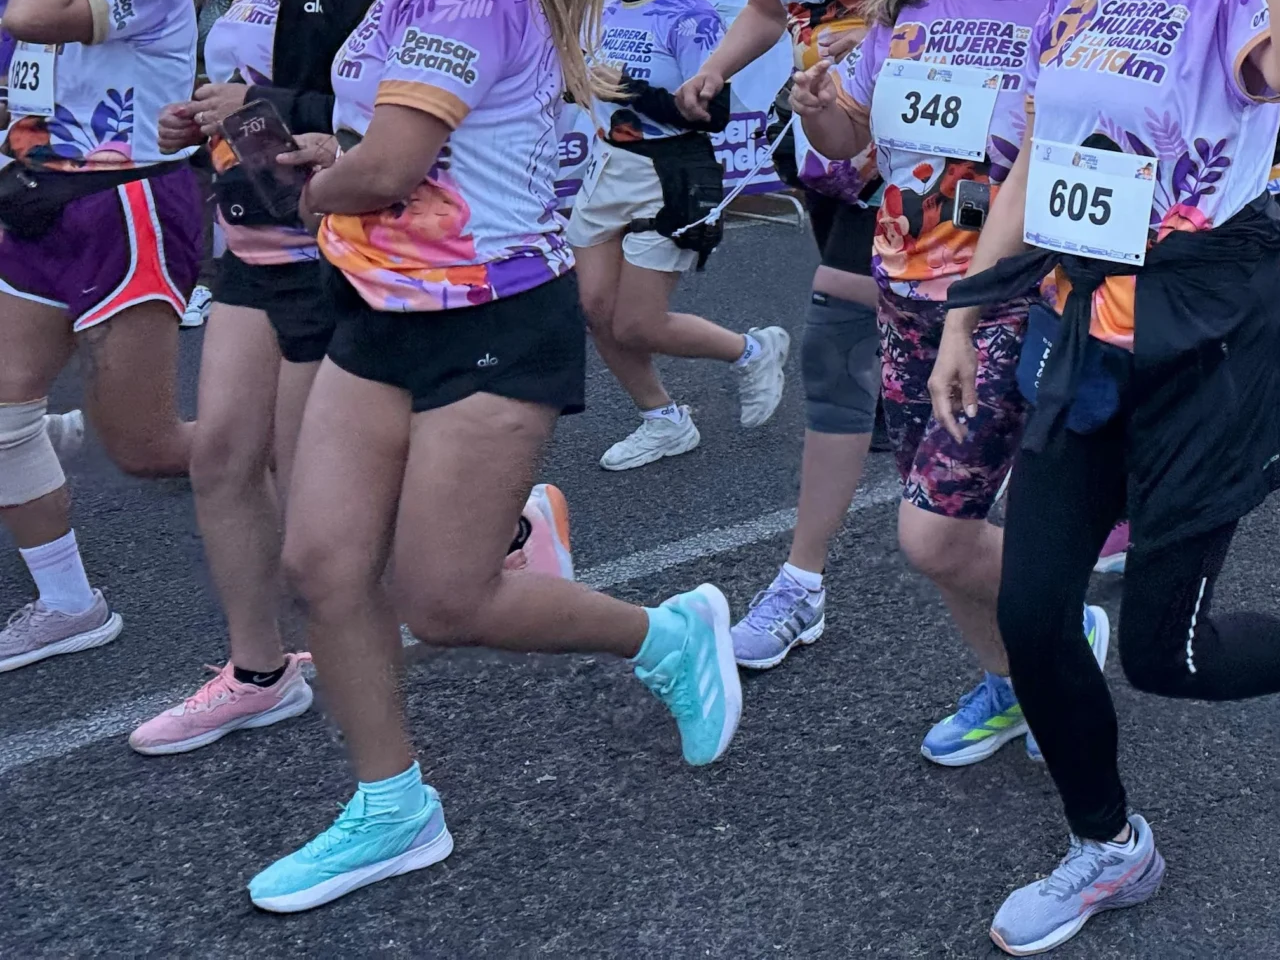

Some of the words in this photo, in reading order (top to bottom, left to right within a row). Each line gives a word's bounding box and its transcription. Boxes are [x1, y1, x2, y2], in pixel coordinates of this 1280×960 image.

[1102, 0, 1176, 20] CARRERA
[607, 28, 648, 41] CARRERA
[930, 20, 1014, 38] CARRERA
[1089, 16, 1182, 42] MUJERES
[402, 29, 477, 62] Pensar
[602, 38, 654, 54] MUJERES
[926, 35, 1028, 58] MUJERES
[1082, 33, 1089, 43] Y
[1090, 35, 1106, 47] LA
[1103, 36, 1172, 56] IGUALDAD
[400, 46, 476, 85] Grande
[608, 52, 652, 63] IGUALDAD
[950, 54, 1024, 68] IGUALDAD
[1065, 46, 1082, 66] 5
[1083, 48, 1100, 70] Y
[1099, 50, 1166, 84] 10km
[901, 91, 962, 128] 348
[240, 117, 266, 138] 7:07
[1049, 179, 1113, 226] 605
[476, 352, 499, 368] alo
[660, 406, 675, 416] alo
